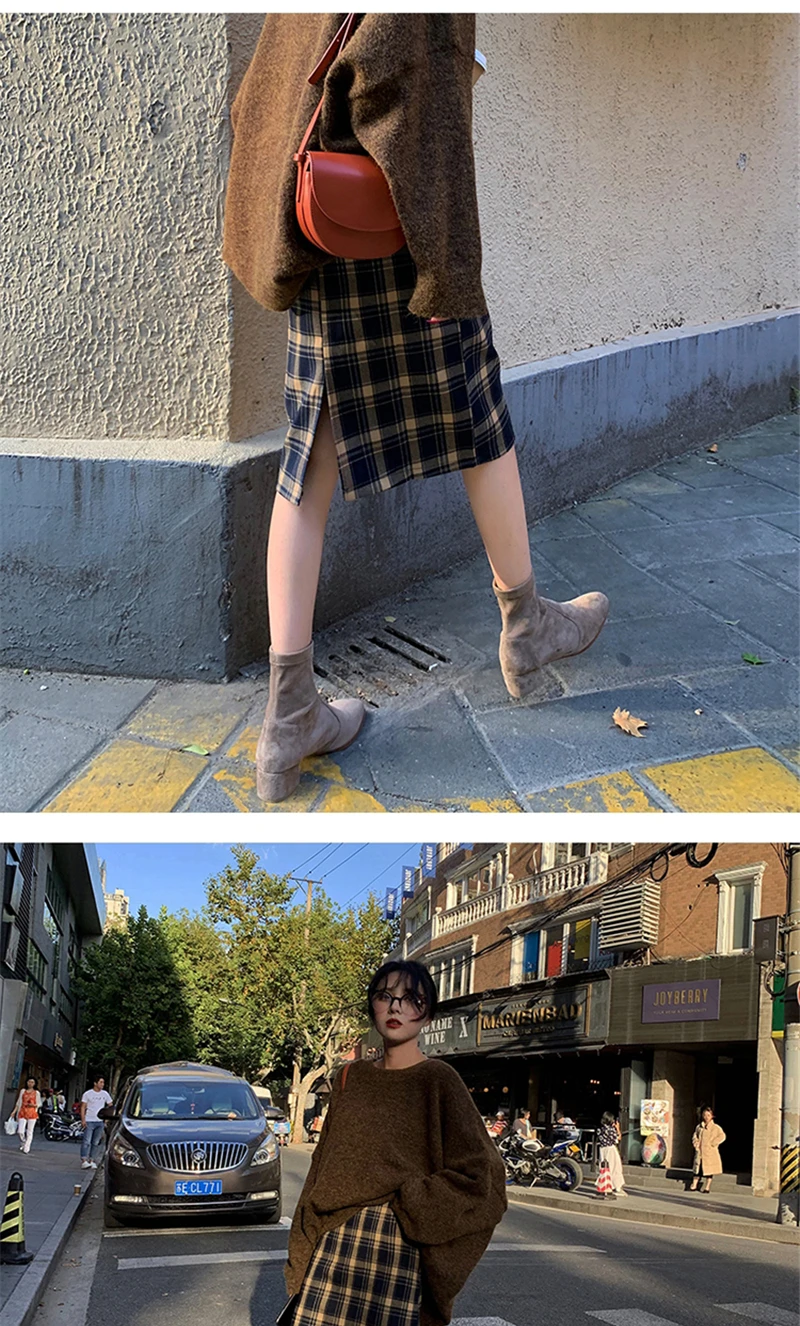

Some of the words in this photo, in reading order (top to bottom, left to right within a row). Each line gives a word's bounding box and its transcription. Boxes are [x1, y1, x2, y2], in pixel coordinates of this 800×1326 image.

[653, 988, 709, 1007] JOYBERRY
[481, 1003, 583, 1030] MARIENBAD
[459, 1016, 469, 1038] X
[424, 1031, 446, 1046] WINE
